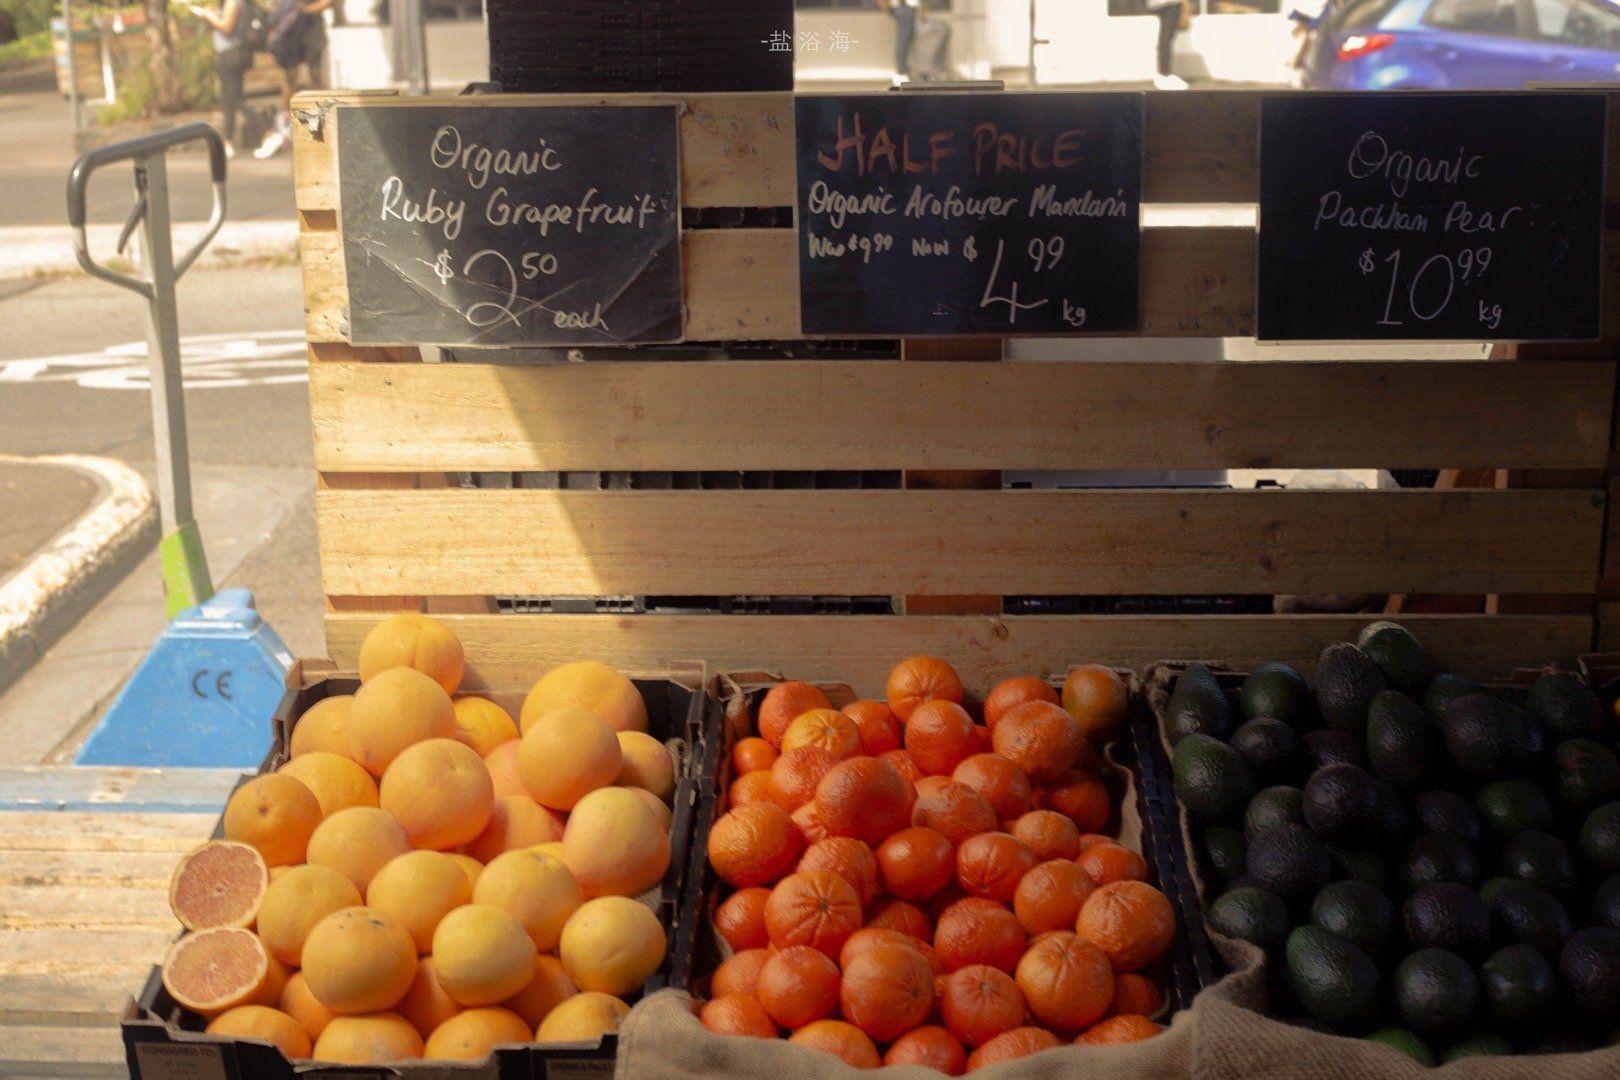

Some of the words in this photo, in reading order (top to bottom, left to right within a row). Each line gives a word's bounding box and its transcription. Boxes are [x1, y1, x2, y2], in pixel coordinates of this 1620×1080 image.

[431, 124, 562, 190] Organic
[816, 110, 957, 178] HALF
[972, 121, 1093, 178] PRICE
[1348, 130, 1484, 198] Organic
[381, 175, 466, 240] Ruby
[485, 186, 656, 237] Grapefruit
[808, 180, 898, 231] Organic
[1444, 200, 1522, 233] Pear
[553, 302, 610, 332] each
[1062, 298, 1087, 327] kg
[1478, 300, 1503, 330] kg
[191, 669, 233, 700] CE
